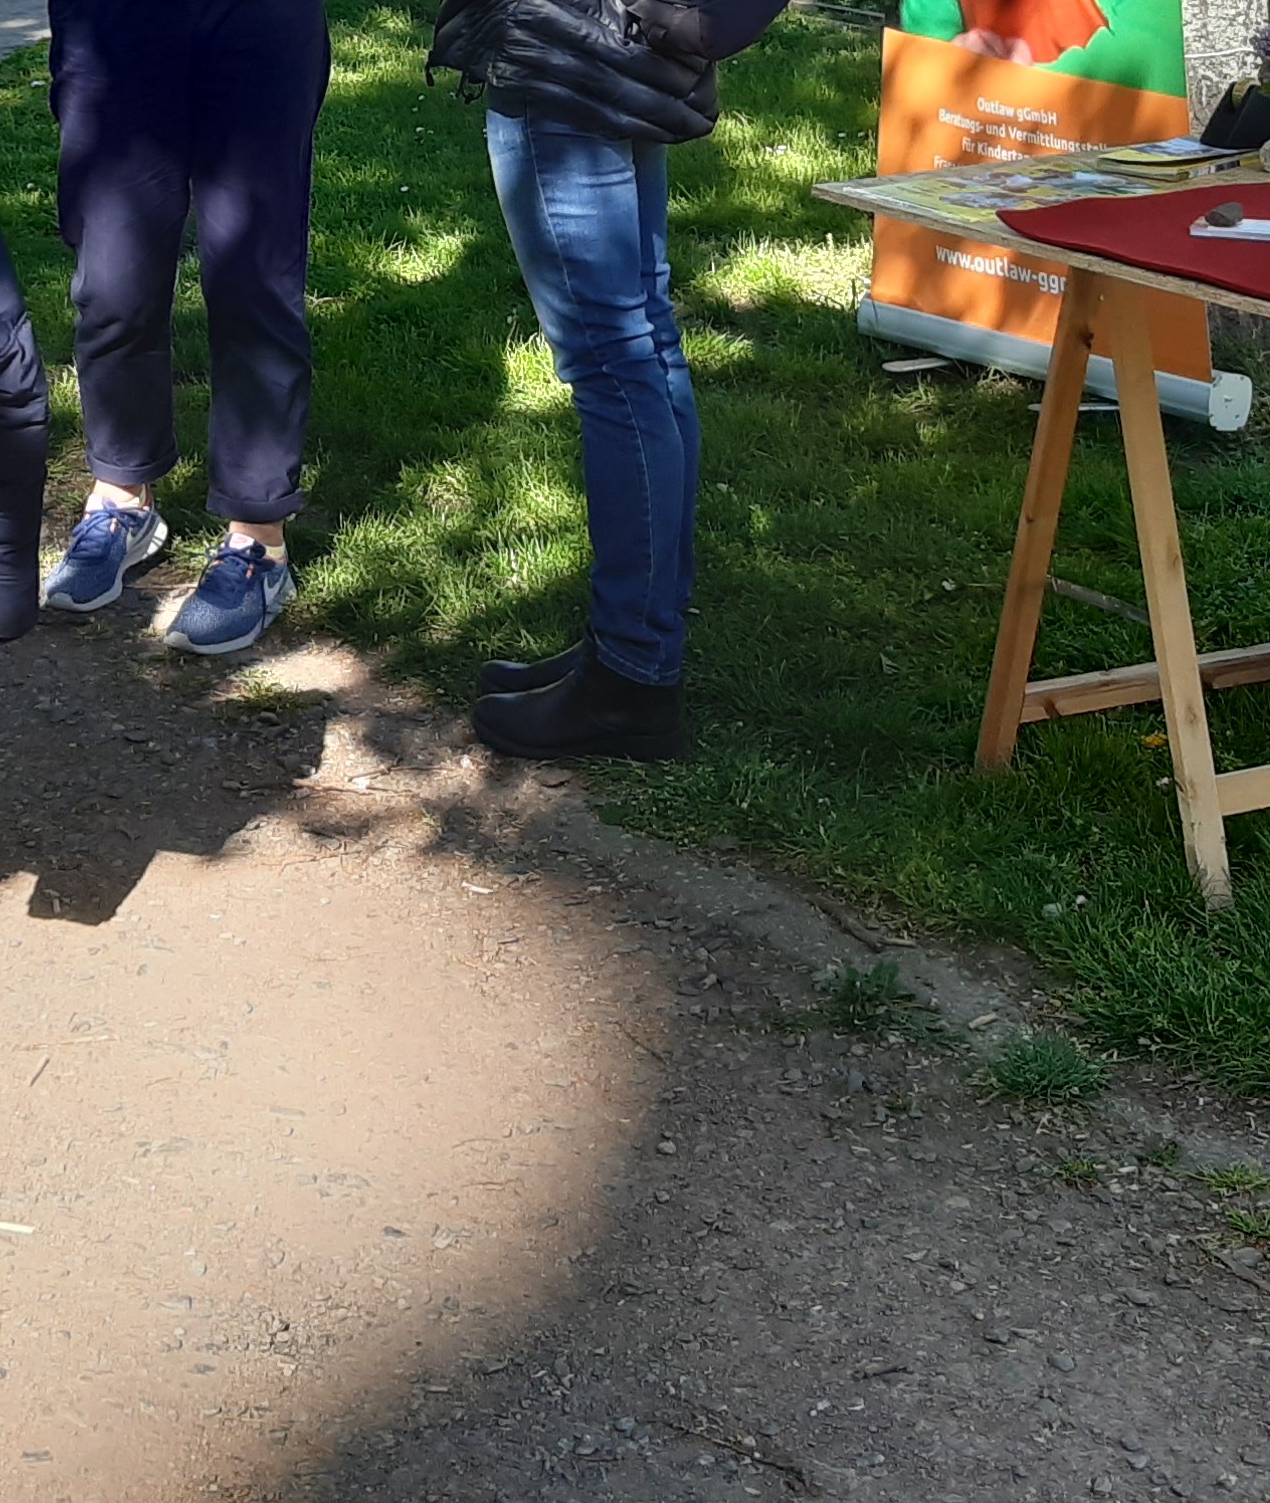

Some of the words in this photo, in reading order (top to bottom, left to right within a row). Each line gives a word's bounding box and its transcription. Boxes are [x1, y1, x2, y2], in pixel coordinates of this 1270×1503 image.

[938, 108, 984, 134] Beratungs-
[985, 123, 1007, 138] und
[977, 97, 1015, 118] Outlaw
[1017, 109, 1058, 126] gGmbH
